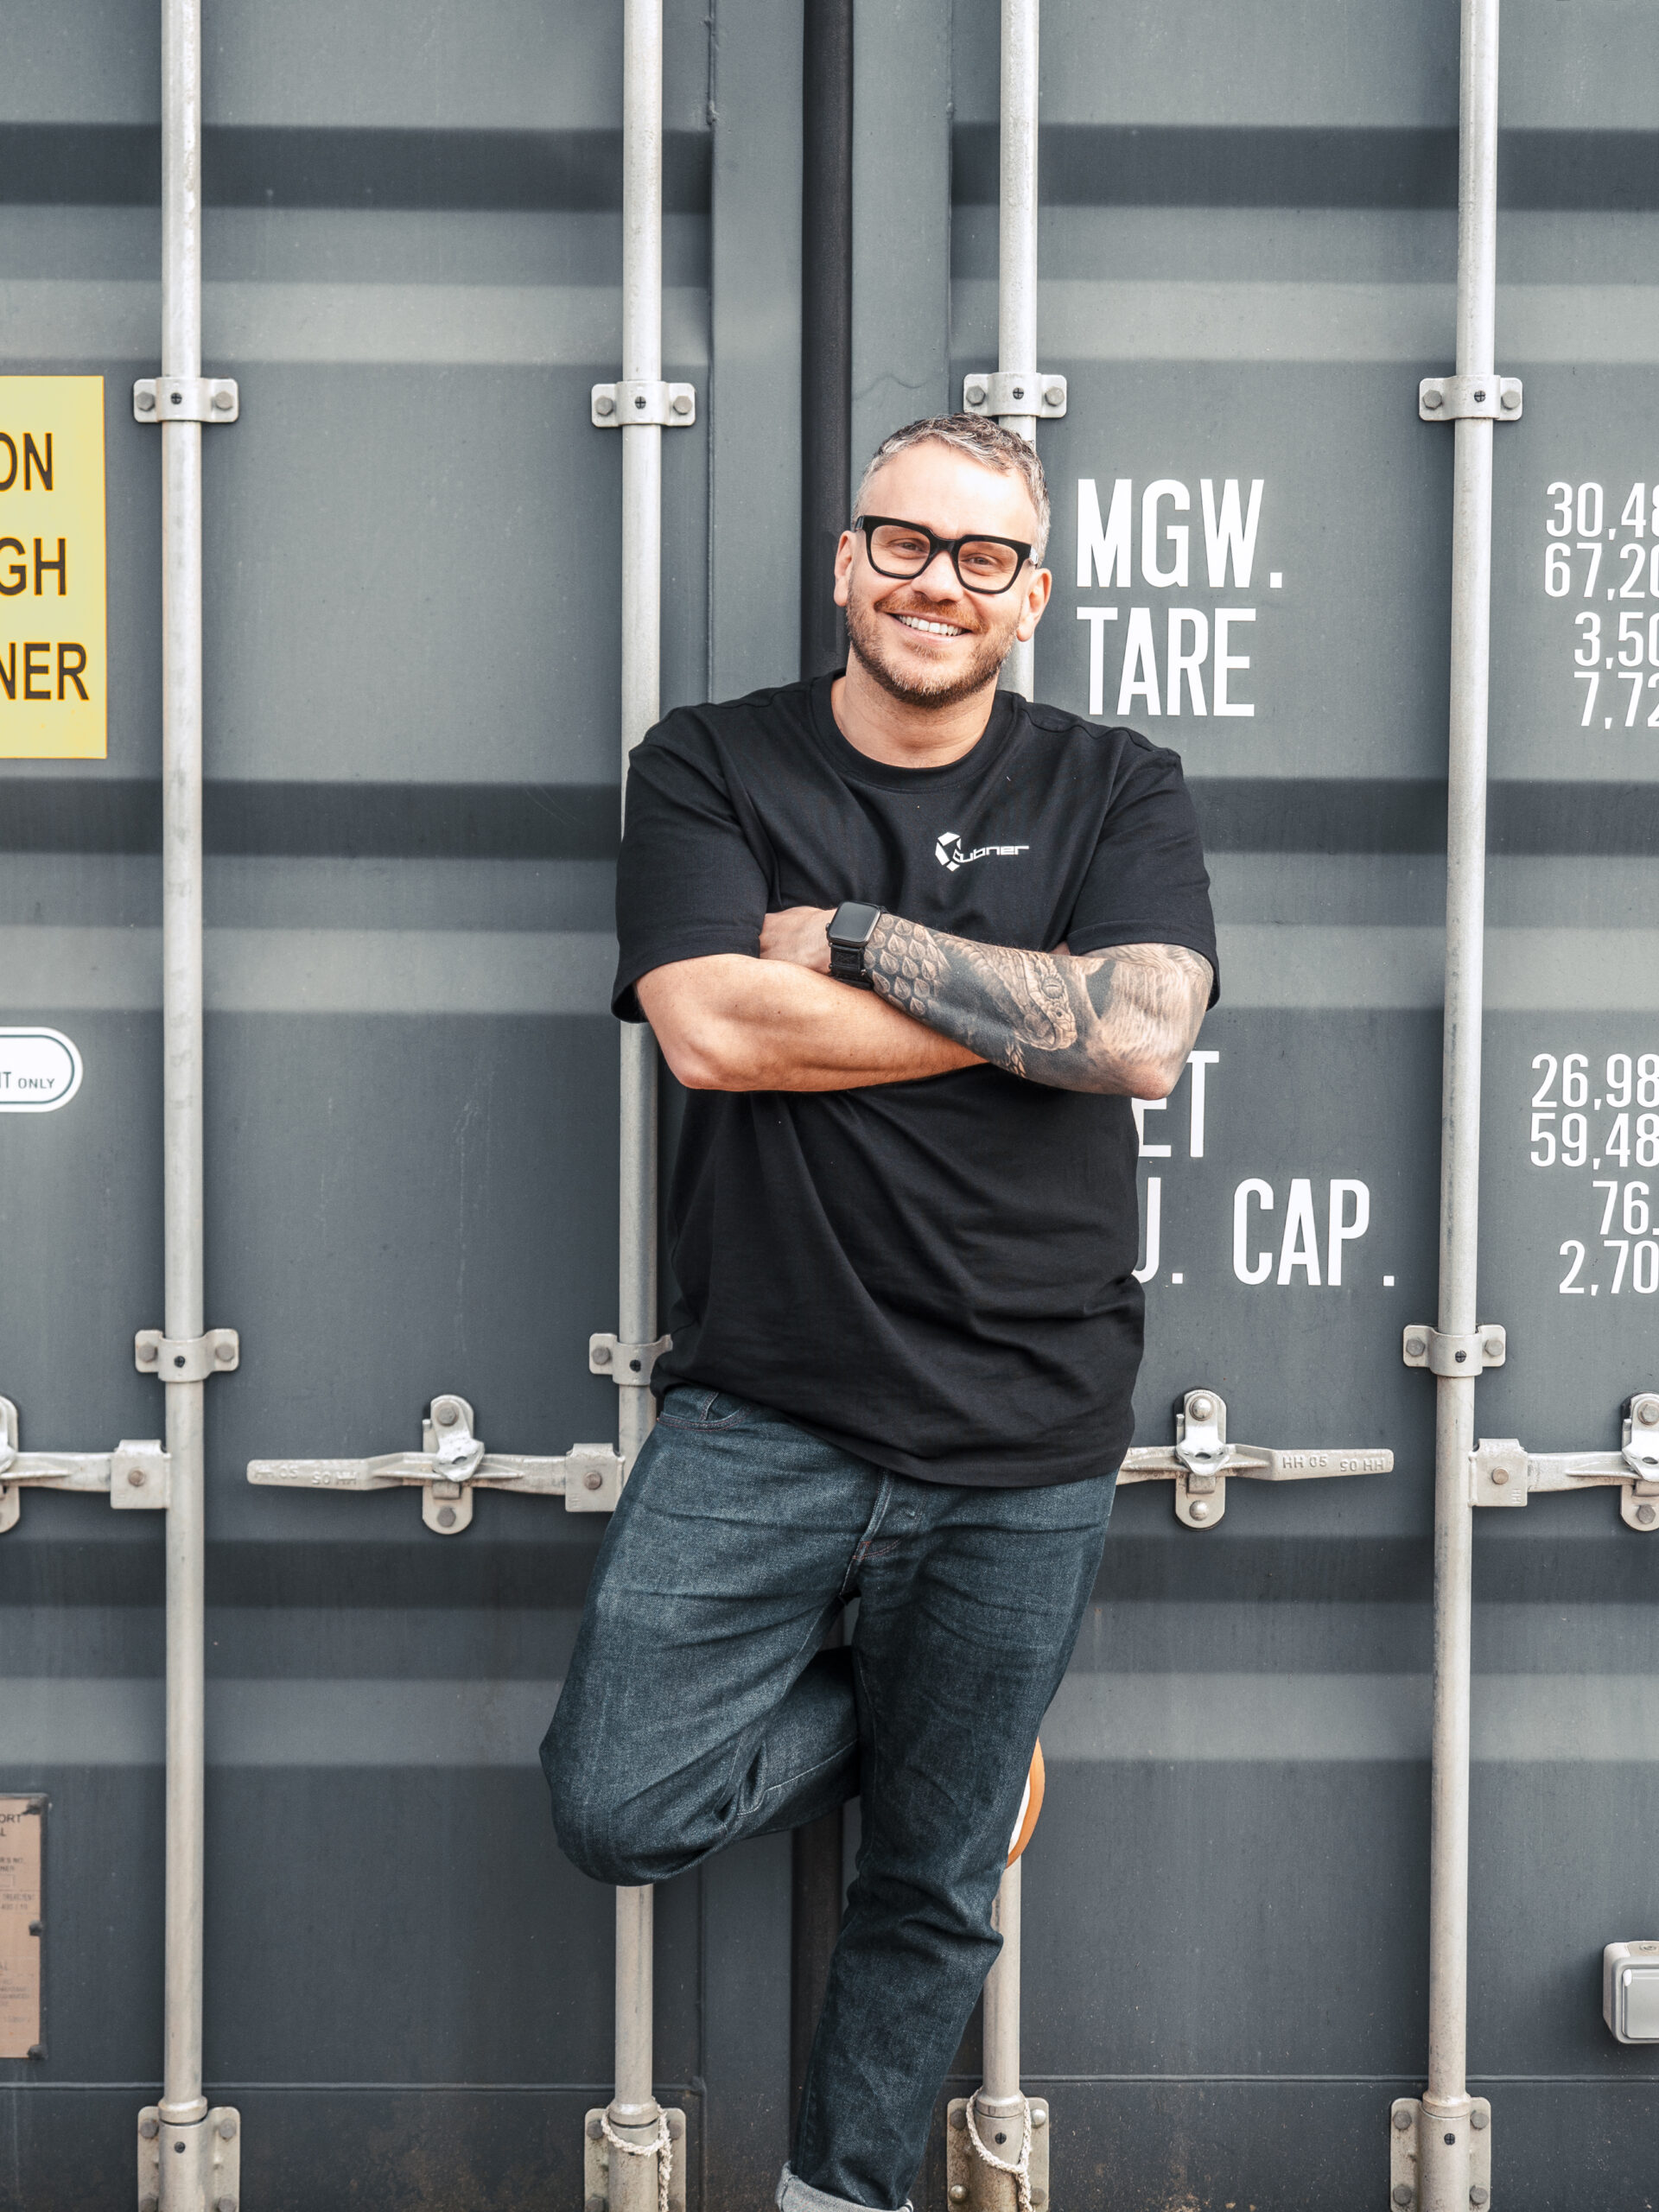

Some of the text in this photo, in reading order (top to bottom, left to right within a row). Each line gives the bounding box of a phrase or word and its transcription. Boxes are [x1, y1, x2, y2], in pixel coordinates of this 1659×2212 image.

[1077, 479, 1283, 588] MGW.
[1546, 481, 1659, 540] 30,4
[0, 537, 67, 596] GH
[1077, 607, 1256, 716] TARE
[18, 1077, 55, 1090] ONLY
[1233, 1179, 1395, 1287] CAP.
